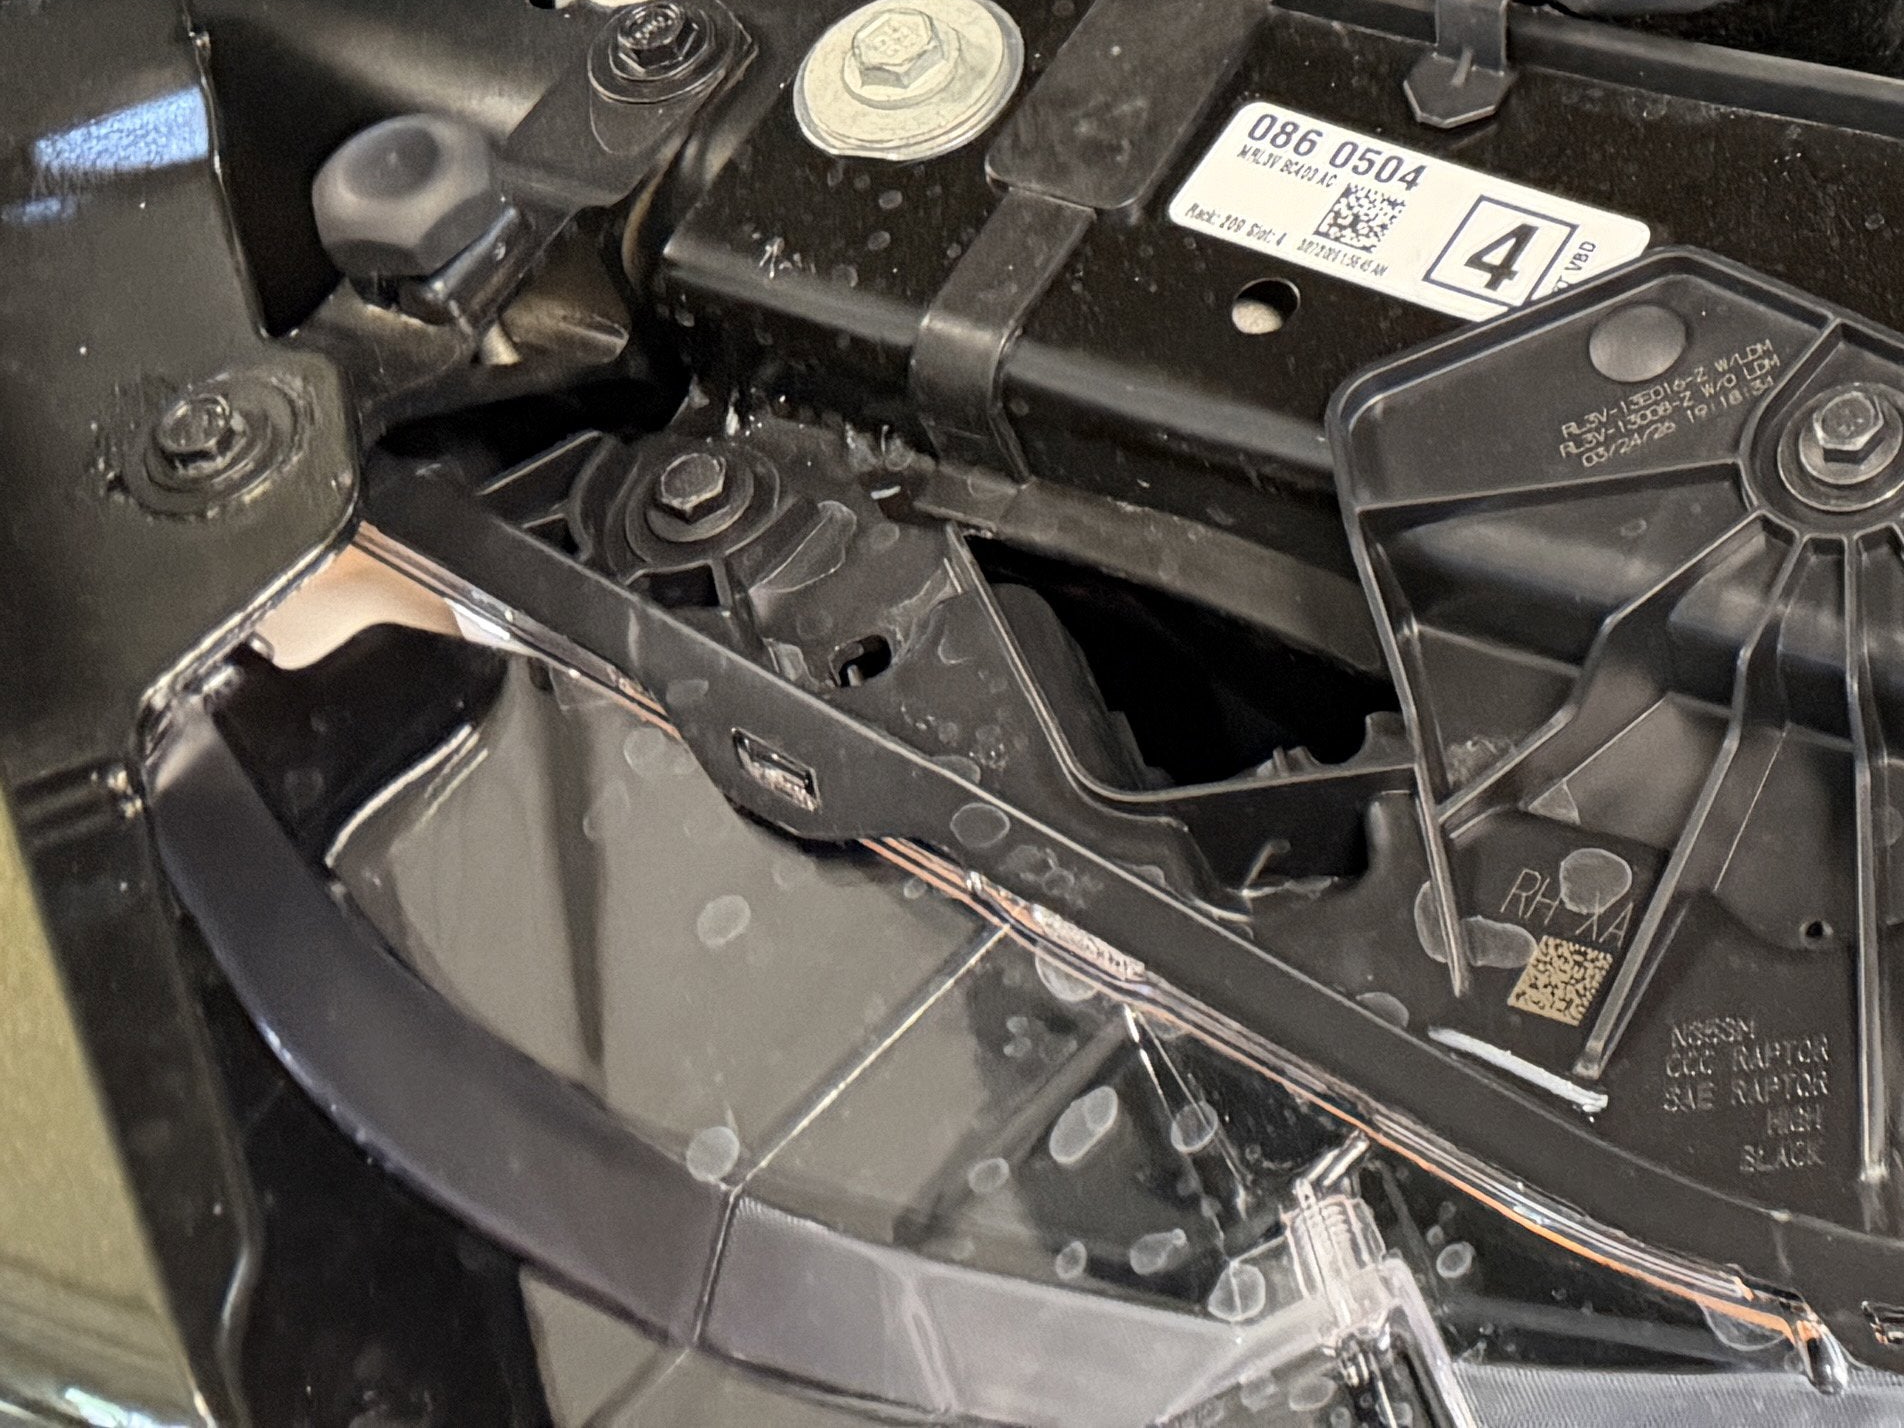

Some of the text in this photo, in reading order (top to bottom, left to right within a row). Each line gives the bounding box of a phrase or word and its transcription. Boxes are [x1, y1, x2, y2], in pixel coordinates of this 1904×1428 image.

[1247, 113, 1427, 193] 086 0504
[1463, 223, 1541, 291] 4
[1561, 239, 1597, 275] VBD
[1700, 372, 1738, 398] W/O
[1742, 353, 1781, 381] LDM
[1500, 867, 1561, 925] RH
